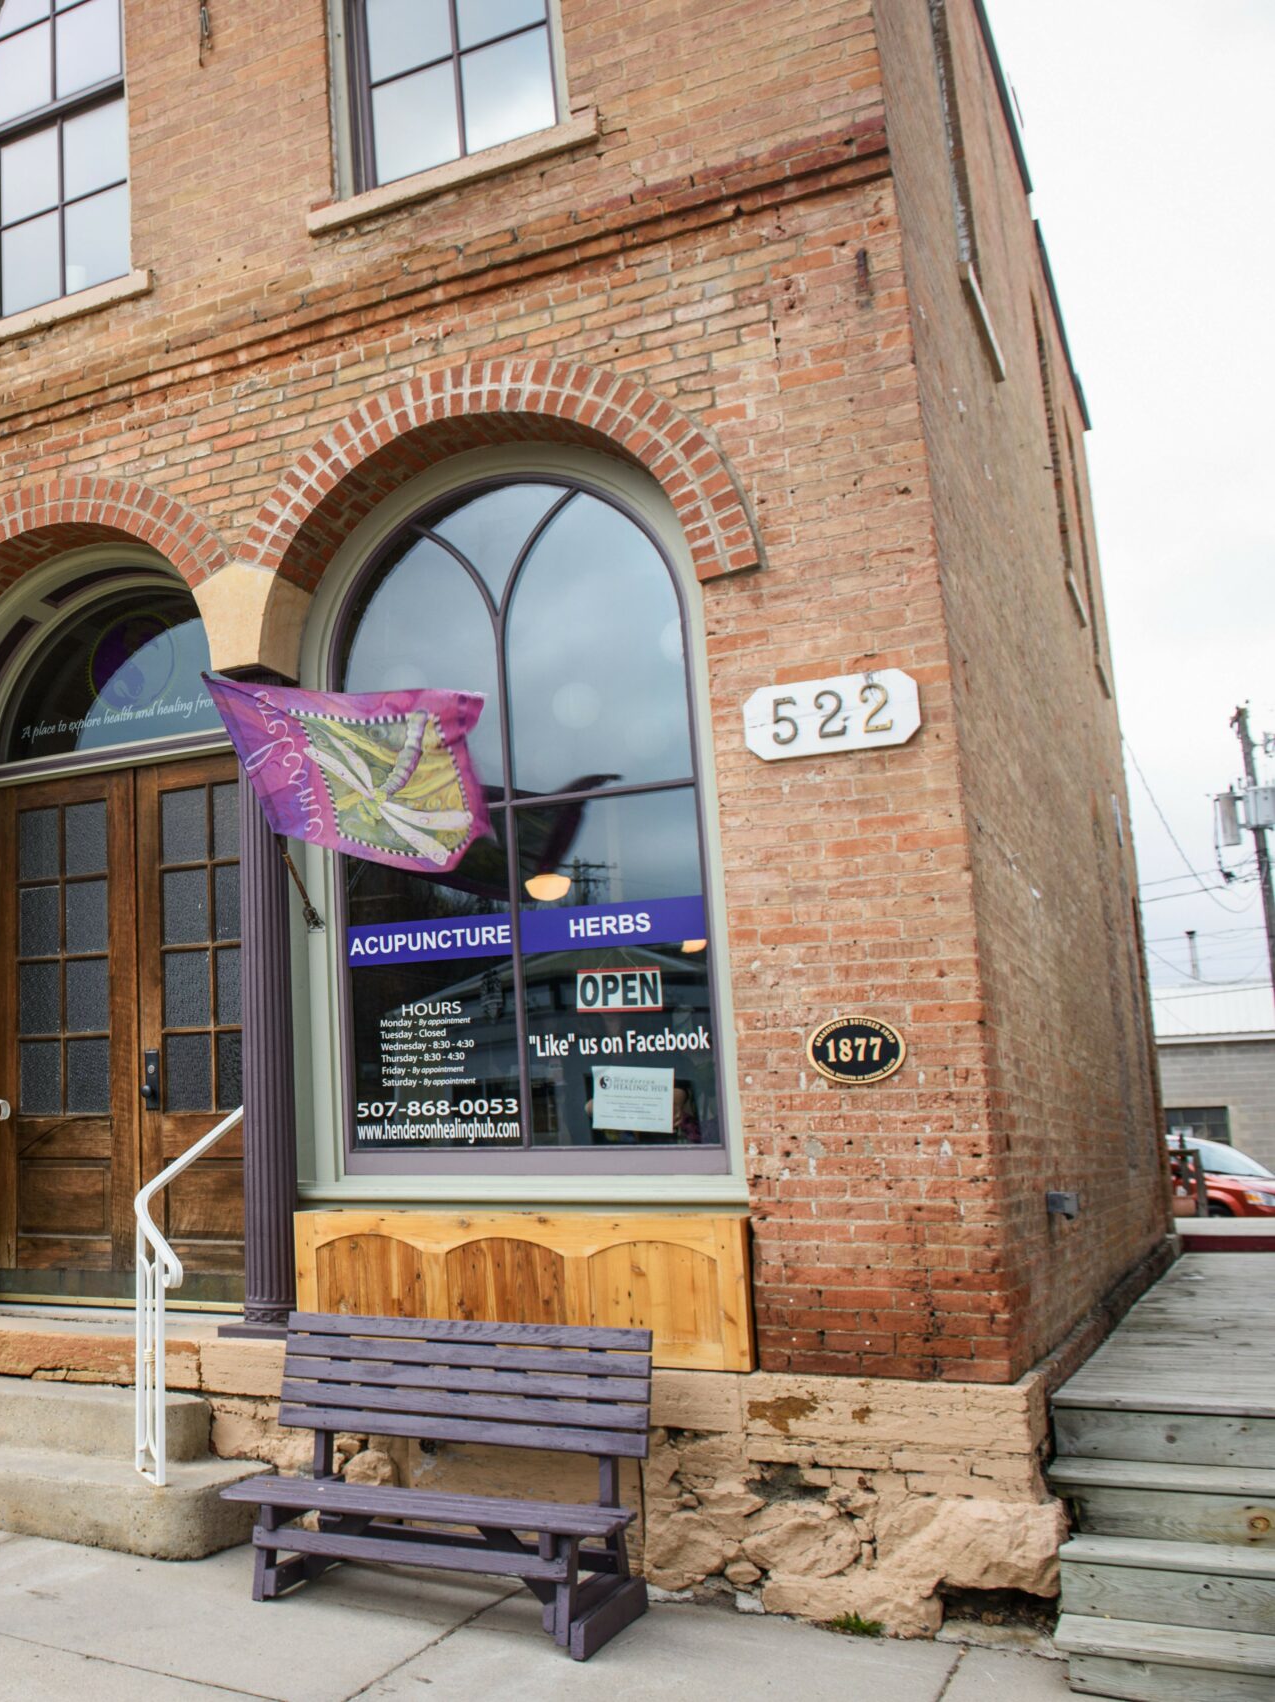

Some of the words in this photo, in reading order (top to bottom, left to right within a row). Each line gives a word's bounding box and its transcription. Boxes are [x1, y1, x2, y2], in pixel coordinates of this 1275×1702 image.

[20, 726, 31, 740] A
[31, 720, 56, 744] place
[58, 721, 67, 733] to
[68, 712, 102, 736] explore
[103, 704, 133, 724] health
[135, 699, 155, 719] and
[156, 696, 193, 719] healing
[773, 682, 893, 745] 522
[569, 912, 651, 938] HERBS
[350, 924, 512, 957] ACUPUNCTURE
[579, 972, 659, 1008] OPEN
[401, 1000, 462, 1016] HOURS
[380, 1018, 413, 1028] Monday
[418, 1018, 427, 1027] By
[427, 1017, 471, 1026] appointment
[380, 1030, 413, 1040] Tuesday
[418, 1028, 447, 1038] Closed
[849, 1018, 881, 1030] BUTCHER
[880, 1027, 896, 1044] SHOP
[380, 1041, 427, 1052] Wednesday
[432, 1040, 451, 1050] 8:30
[456, 1039, 475, 1048] 4:30
[528, 1033, 575, 1058] "Like"
[579, 1037, 598, 1055] us
[601, 1036, 623, 1054] on
[626, 1025, 710, 1053] Facebook
[826, 1036, 883, 1062] 1877
[381, 1053, 418, 1064] Thursday
[423, 1052, 442, 1062] 8:30
[447, 1051, 466, 1061] 4:30
[381, 1065, 406, 1076] Friday
[412, 1066, 421, 1075] By
[421, 1065, 465, 1075] appointment
[382, 1077, 418, 1088] Saturday
[423, 1078, 432, 1088] By
[432, 1077, 476, 1087] appointment
[357, 1098, 519, 1118] 507-868-0053
[357, 1116, 521, 1144] www.hendersonhealinghub.com
